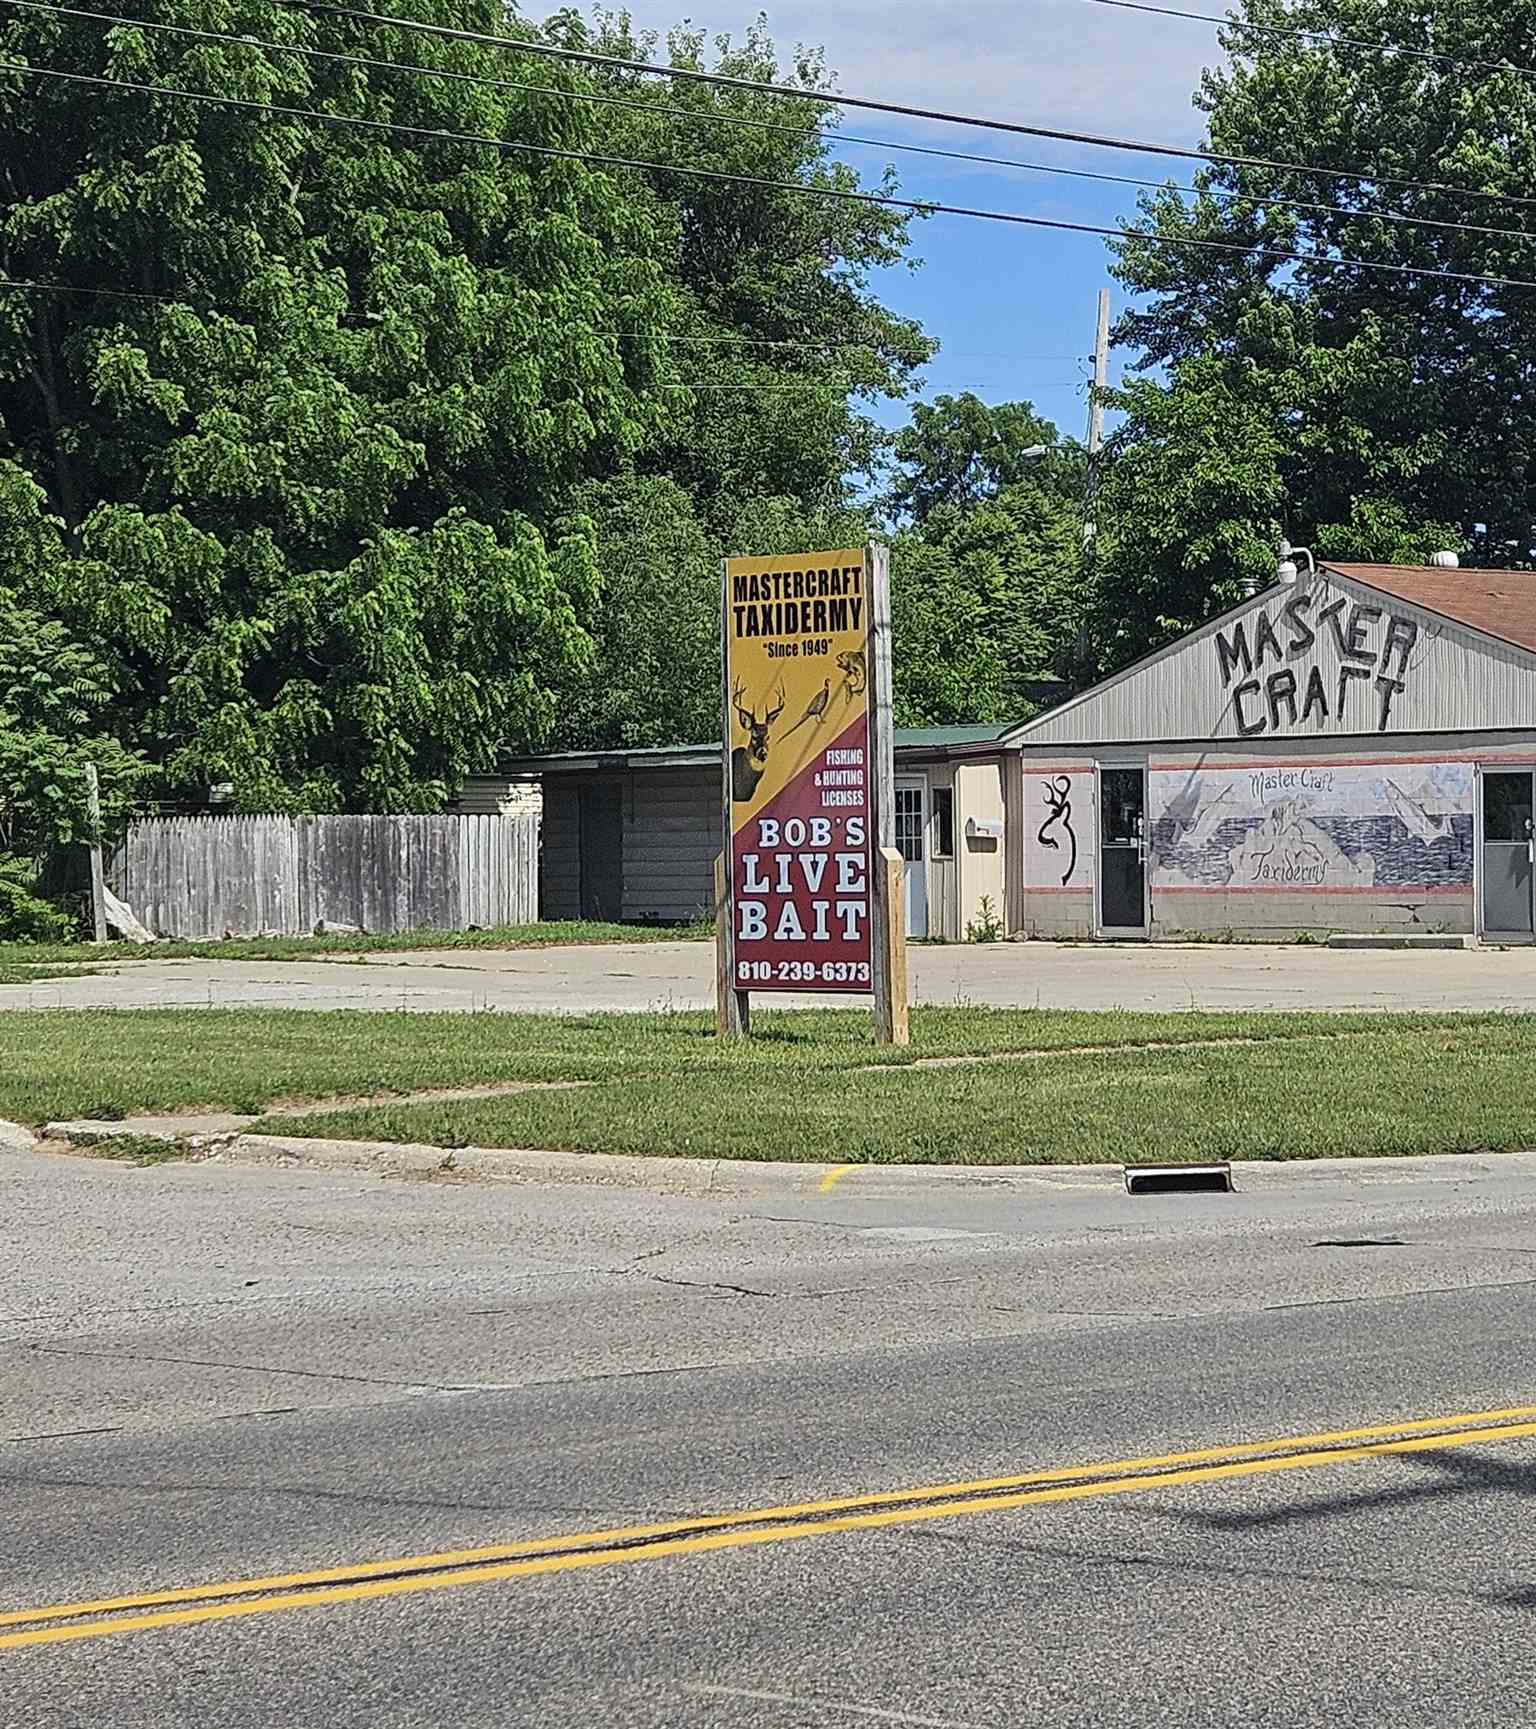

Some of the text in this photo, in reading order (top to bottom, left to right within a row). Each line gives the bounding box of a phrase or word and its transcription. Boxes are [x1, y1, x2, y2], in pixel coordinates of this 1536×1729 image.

[733, 566, 862, 603] MASTERCRAFT
[733, 597, 862, 638] TAXIDERMY
[1215, 595, 1417, 689] MASTER
[1233, 664, 1406, 736] CRAFT
[826, 749, 863, 766] FISHING
[814, 769, 863, 786] & HUNTING
[1249, 768, 1334, 805] Master Craft
[821, 789, 864, 807] LICENSES
[758, 817, 865, 848] BOB'S
[742, 852, 866, 893] LIVE
[738, 901, 866, 940] BAIT
[738, 961, 870, 981] 810-239-6373
